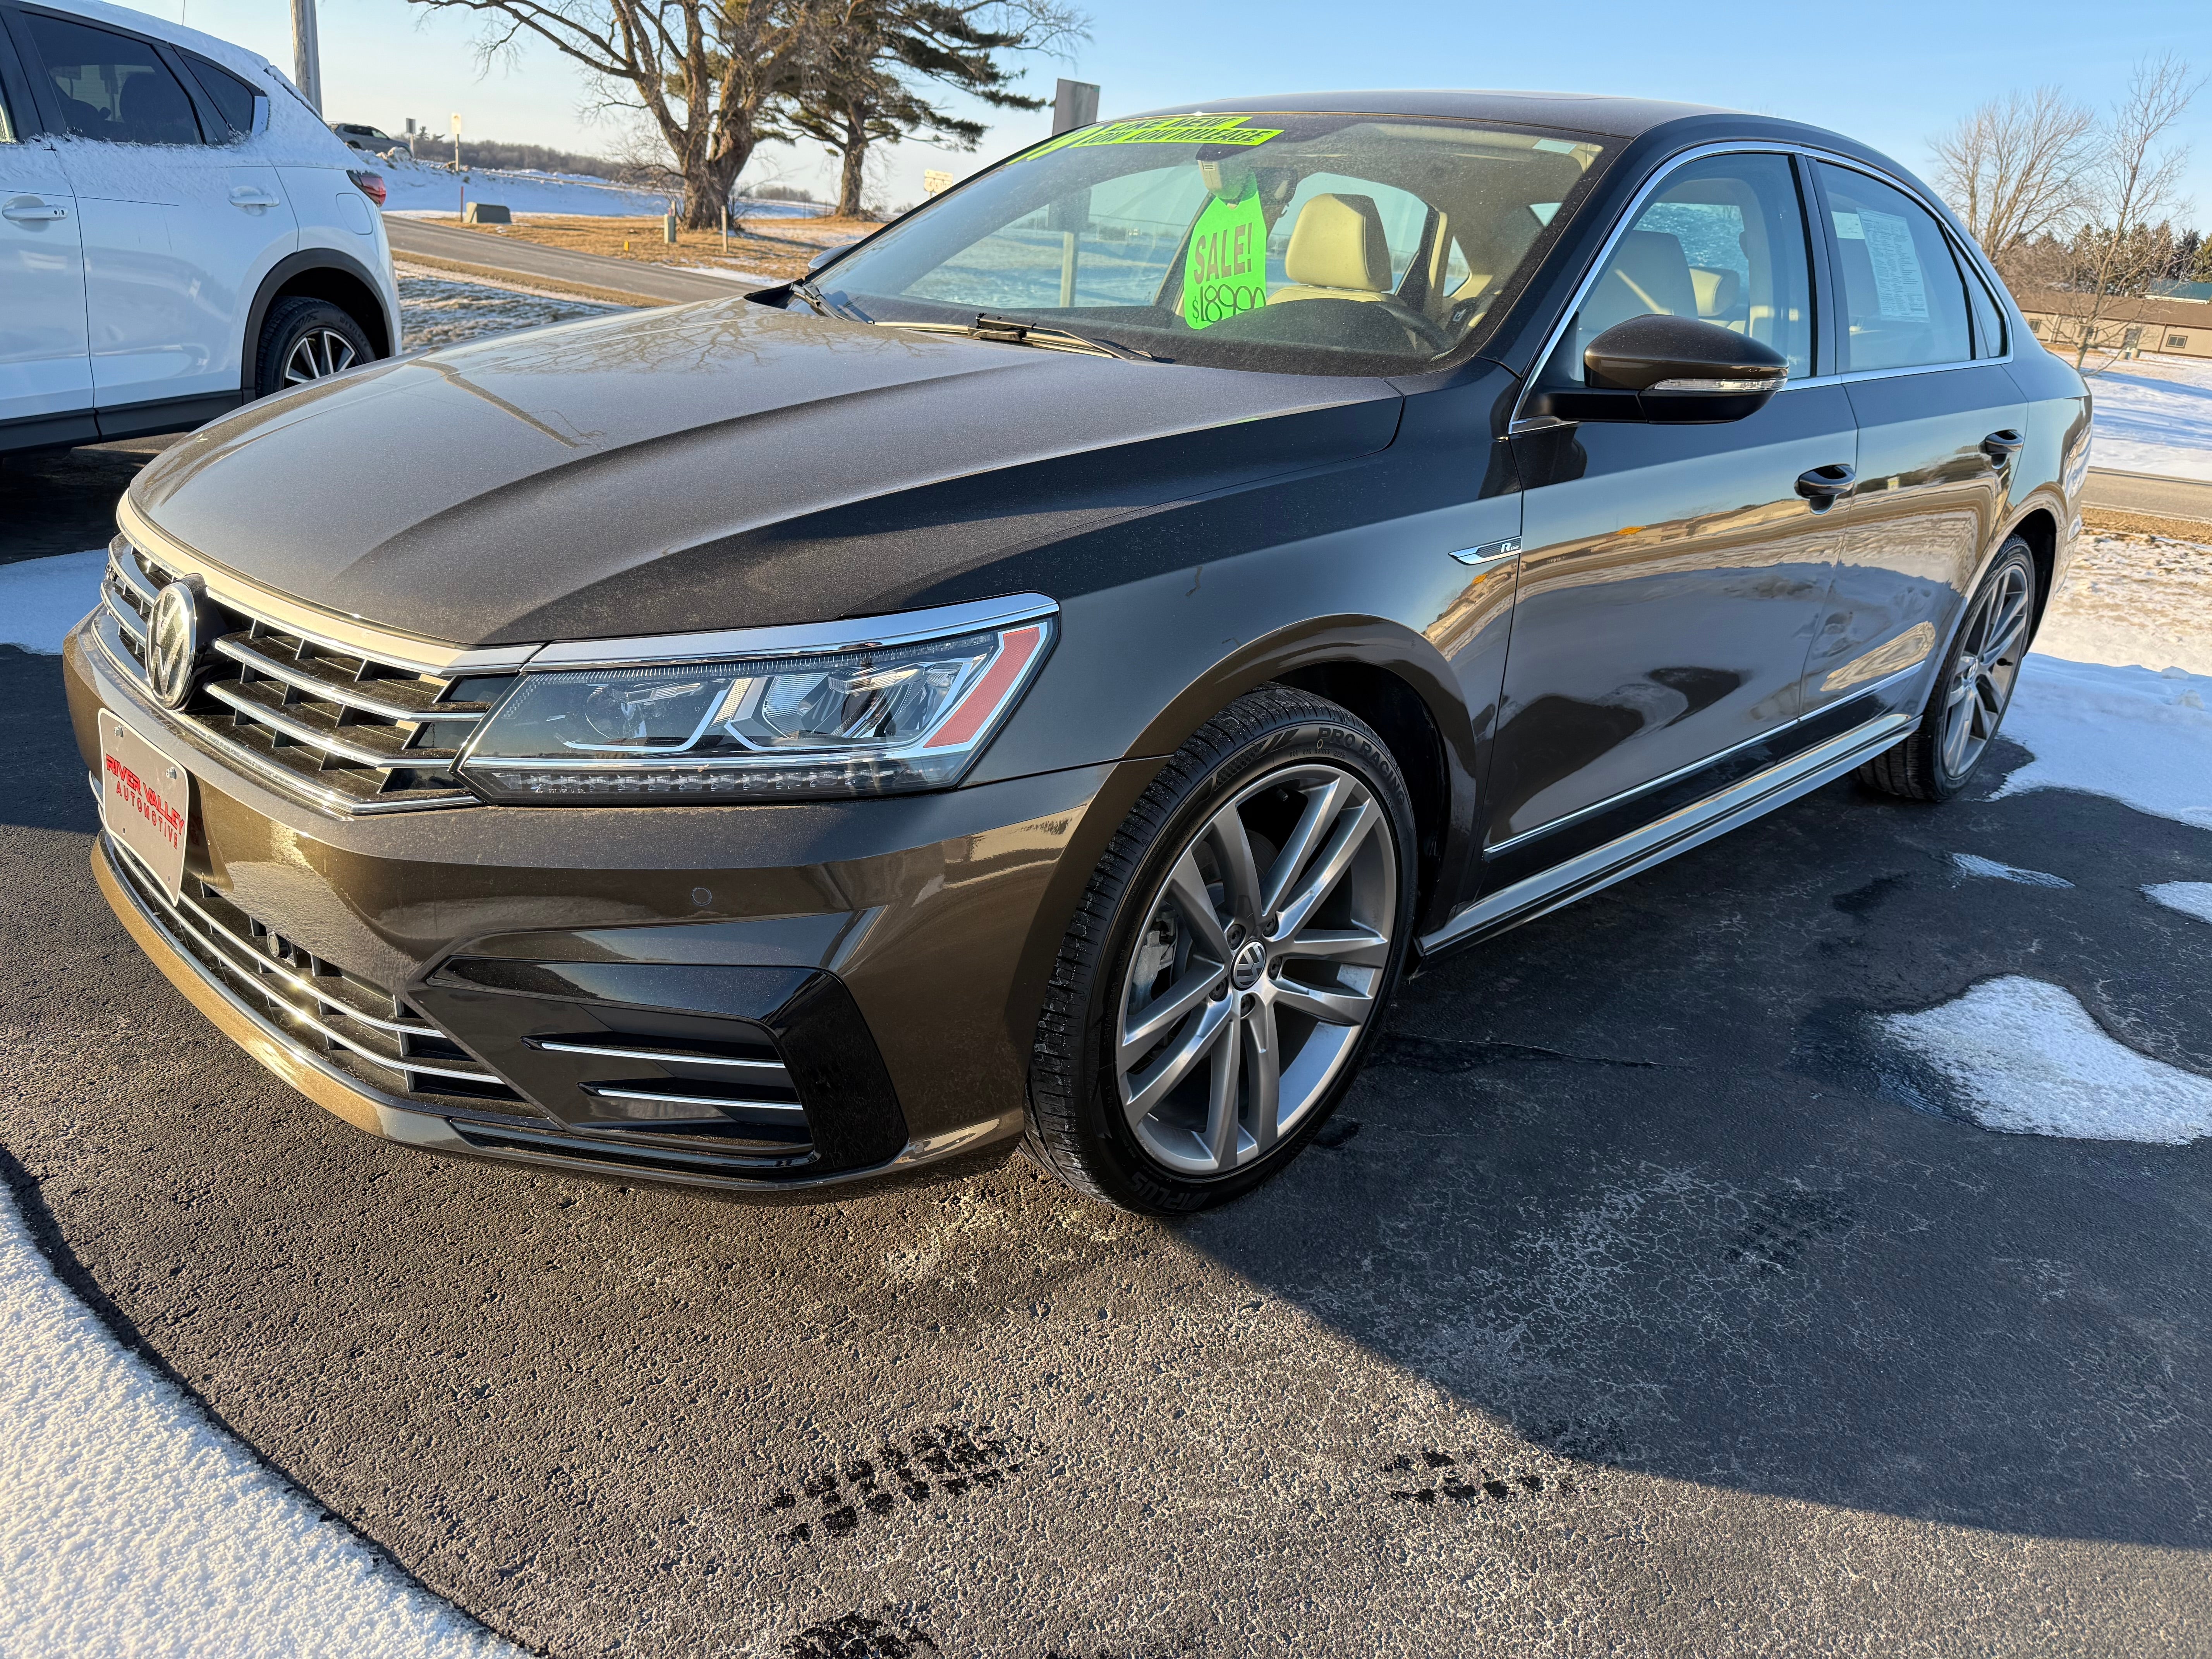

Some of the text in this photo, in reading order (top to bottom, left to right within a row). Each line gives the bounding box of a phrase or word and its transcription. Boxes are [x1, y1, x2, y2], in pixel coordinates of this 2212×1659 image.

[1123, 129, 1183, 142] LOW
[1165, 129, 1273, 143] MILEAGE
[1162, 117, 1240, 128] NEW
[1194, 222, 1252, 285] SALE!
[1500, 542, 1511, 553] R
[1317, 727, 1405, 806] PRO RACING
[106, 753, 143, 797] RIVER
[143, 781, 185, 836] VALLEY
[116, 780, 178, 850] AUTOMOTIVE
[1131, 1171, 1211, 1210] APLUS
